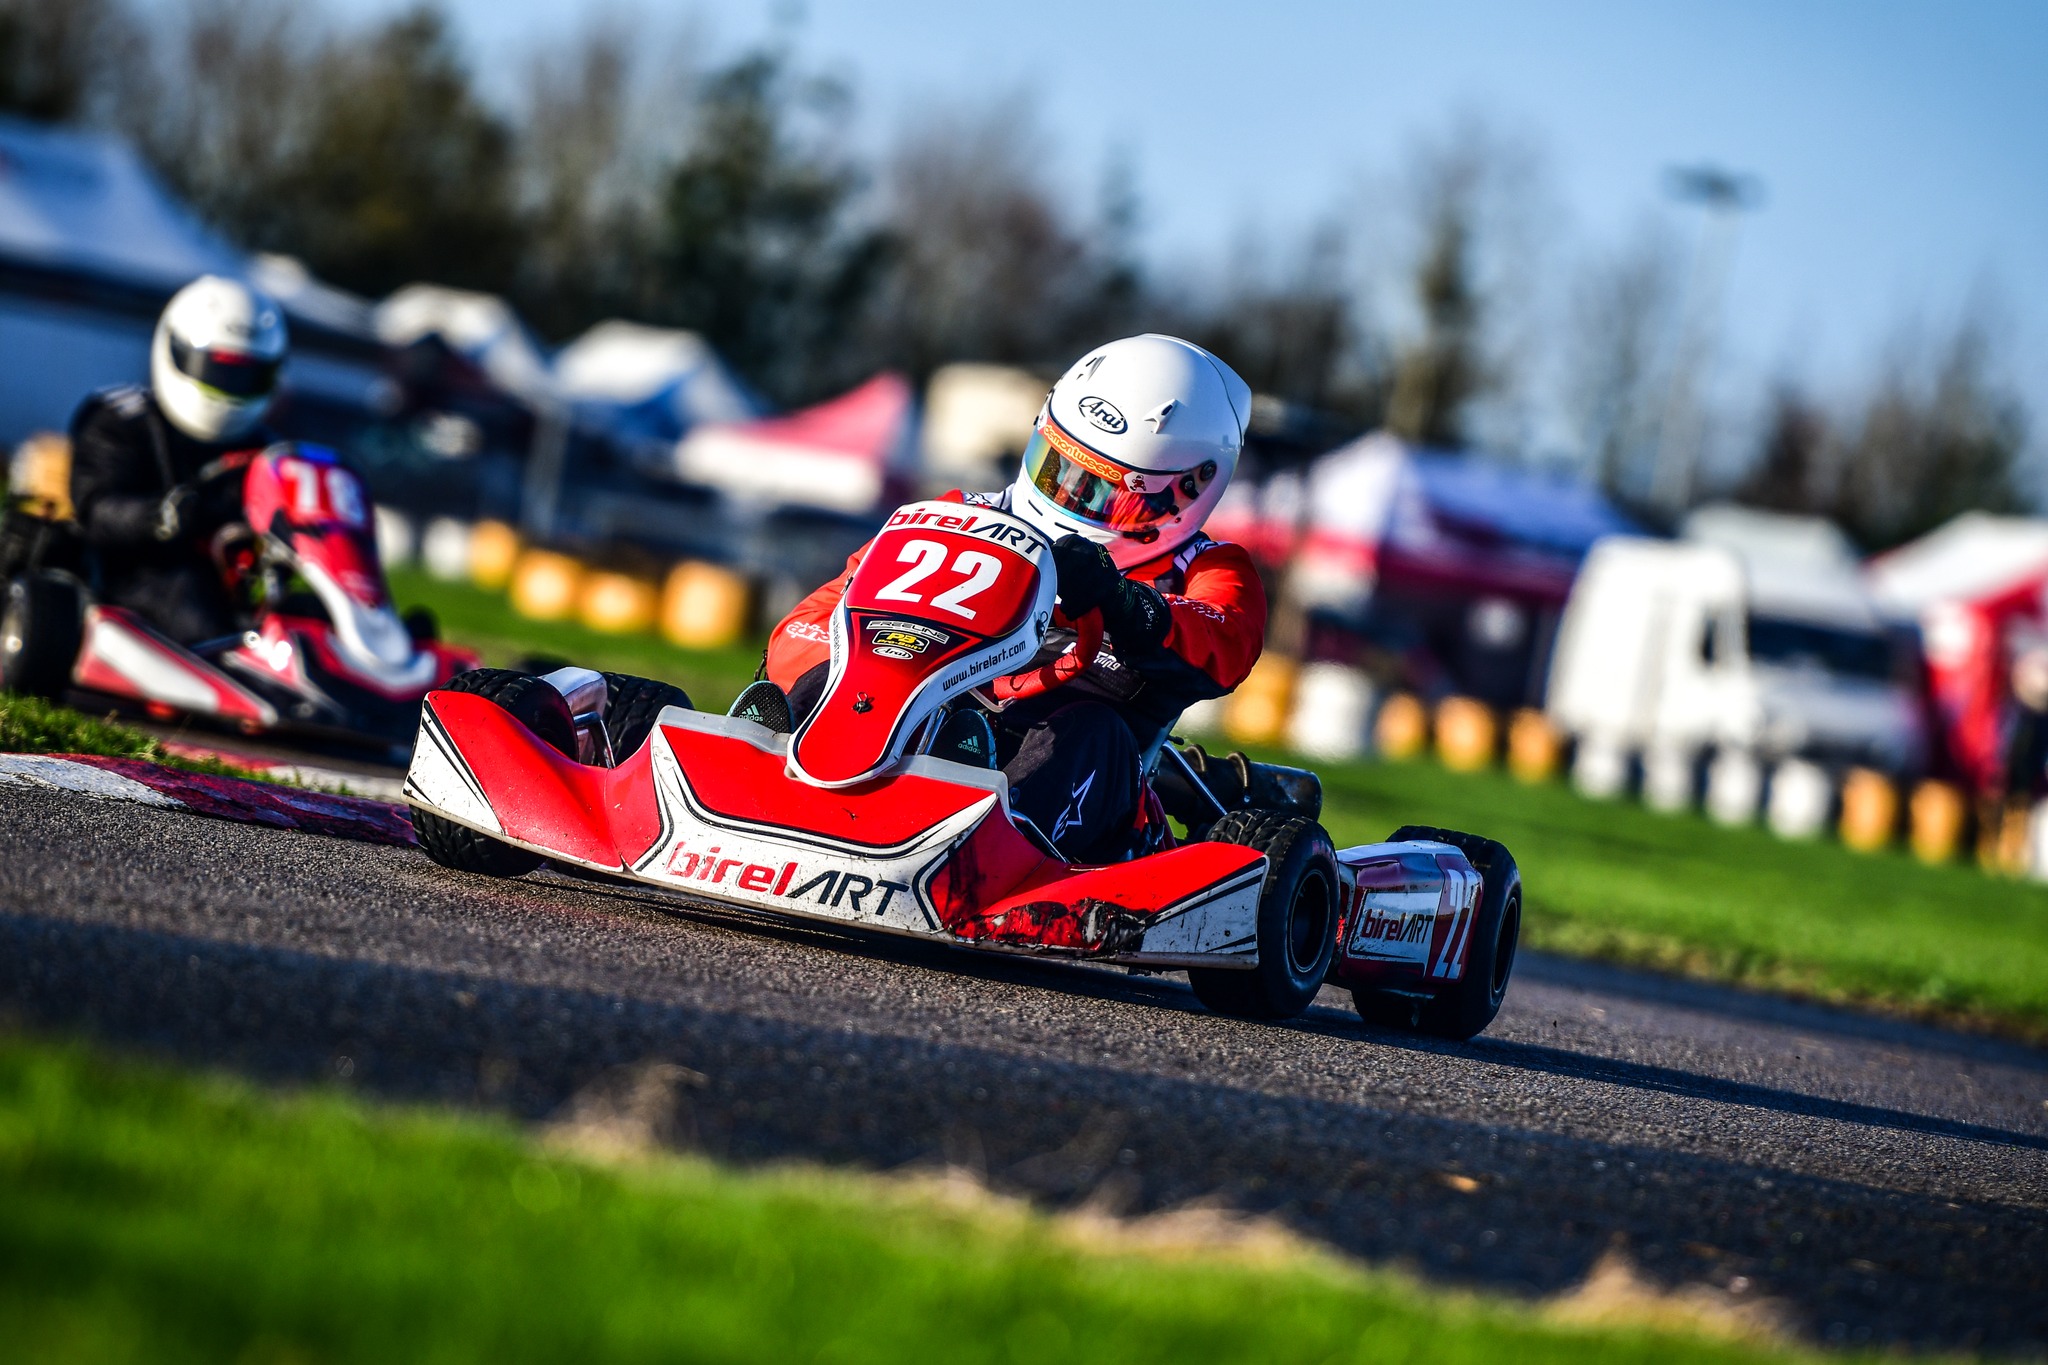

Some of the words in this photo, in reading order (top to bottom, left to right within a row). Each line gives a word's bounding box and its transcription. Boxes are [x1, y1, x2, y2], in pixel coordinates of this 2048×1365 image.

[1080, 401, 1124, 429] Arai
[886, 508, 1048, 555] birelART
[875, 539, 1003, 620] 22
[942, 640, 1026, 691] www.birelart.com
[739, 714, 763, 722] adidas
[957, 743, 981, 754] adidas
[666, 841, 909, 916] birelART
[1361, 908, 1436, 944] birelART
